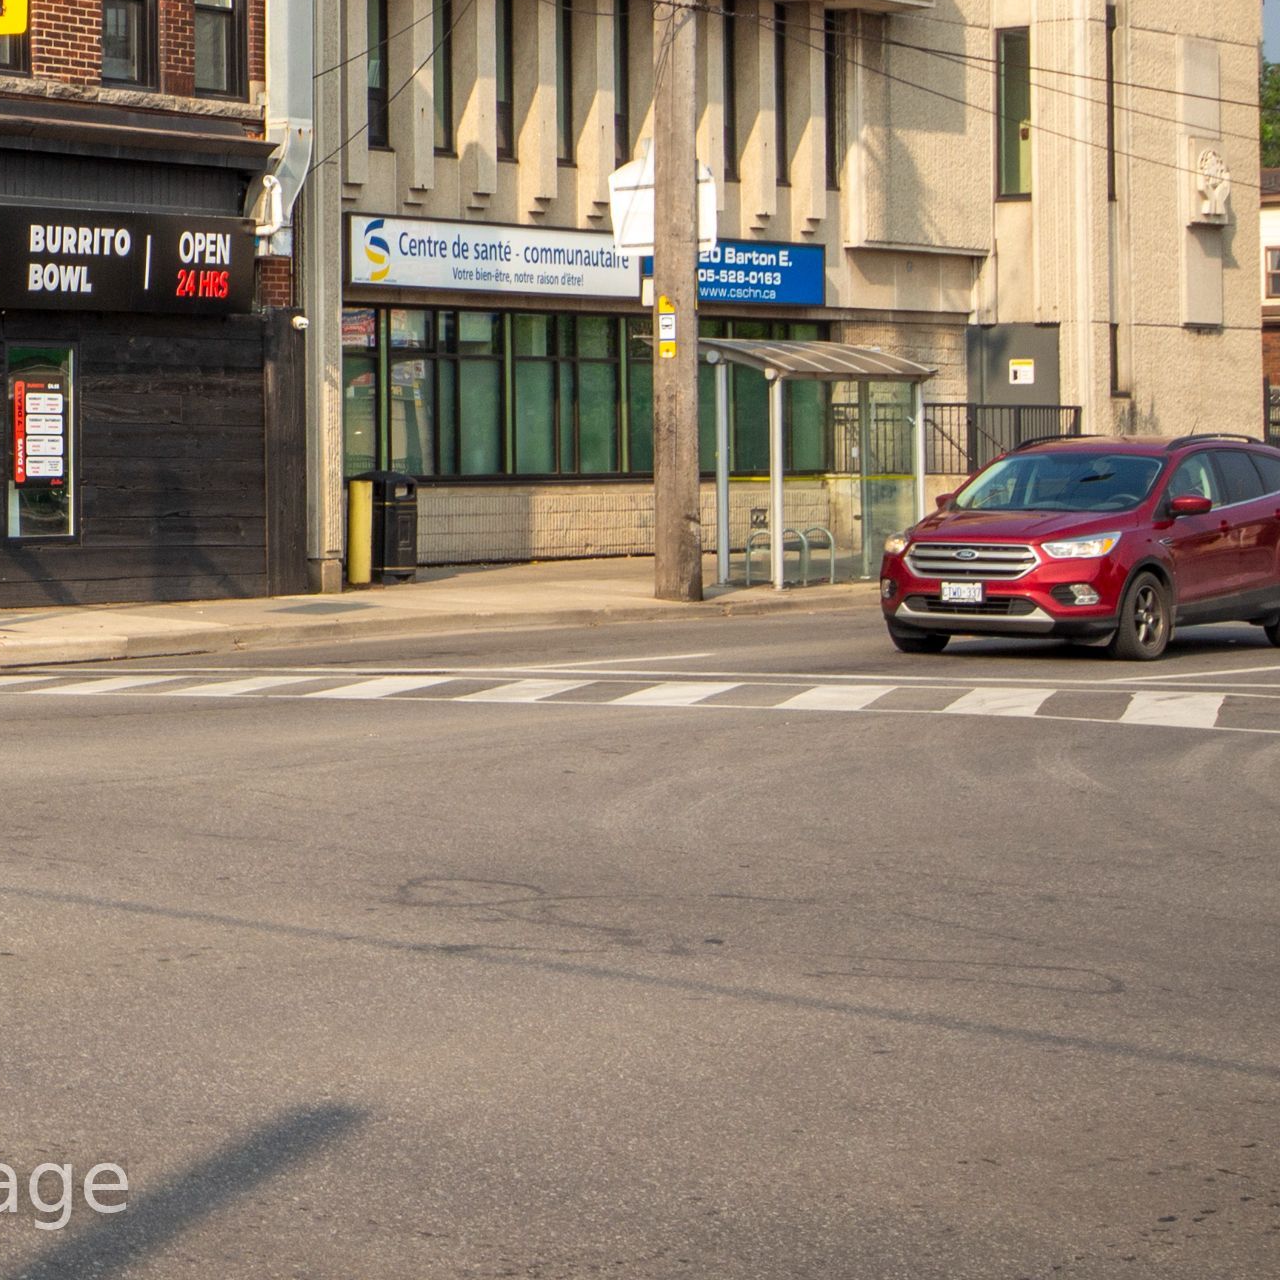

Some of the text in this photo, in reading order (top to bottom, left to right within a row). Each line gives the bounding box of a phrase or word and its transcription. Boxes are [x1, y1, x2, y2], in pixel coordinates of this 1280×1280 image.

[29, 224, 131, 256] BURRITO
[179, 231, 231, 265] OPEN
[398, 232, 448, 258] Centre
[452, 234, 469, 260] de
[473, 240, 512, 262] santé
[523, 244, 629, 269] communautaire
[699, 247, 721, 263] 20
[724, 247, 776, 266] Barton
[28, 263, 92, 293] BOWL
[176, 269, 229, 298] 24 HRS
[452, 267, 584, 287] Votre bien-être, notre raison d'être!
[698, 269, 781, 286] 05-528-0163
[699, 286, 777, 300] www.cschn.ca
